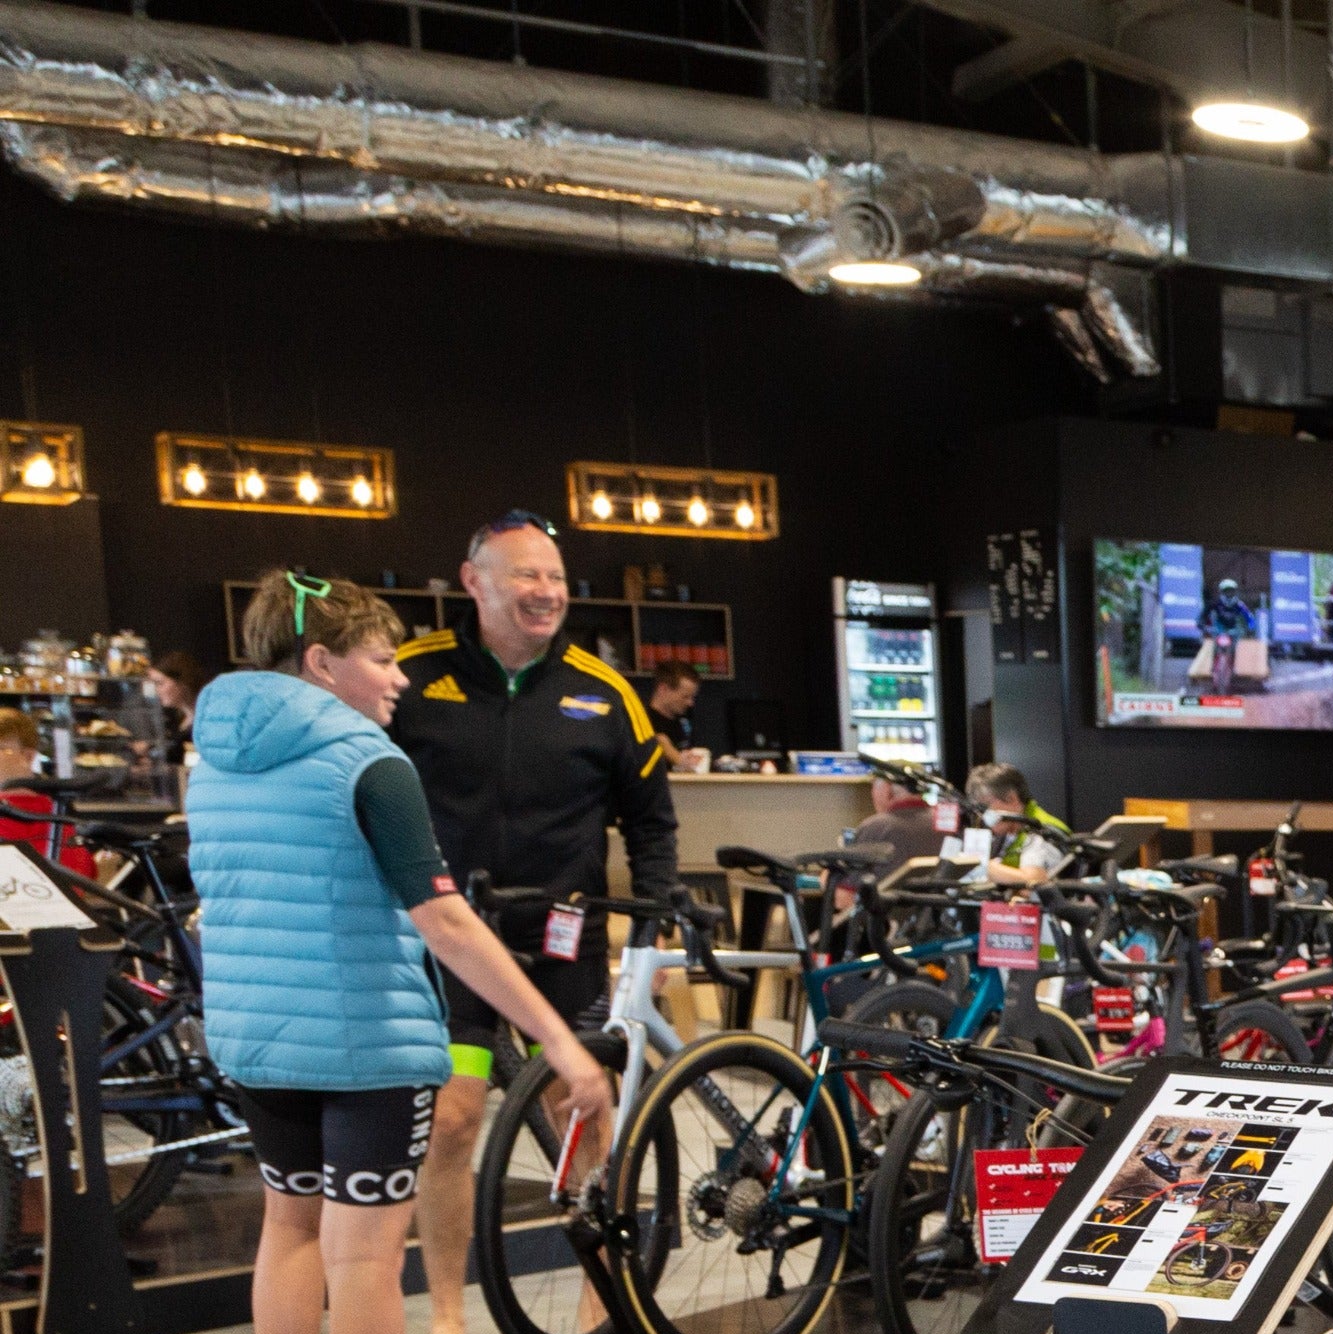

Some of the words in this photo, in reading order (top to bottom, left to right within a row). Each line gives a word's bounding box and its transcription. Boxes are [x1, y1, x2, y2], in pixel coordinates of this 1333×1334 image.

[1220, 1061, 1253, 1071] PLEASE
[1253, 1063, 1266, 1071] DO
[1267, 1064, 1286, 1072] NOT
[1287, 1065, 1316, 1074] TOUCH
[1206, 1110, 1270, 1123] CHECKPOINT
[986, 1163, 1044, 1176] CYCLING
[1060, 1265, 1108, 1277] GRX
